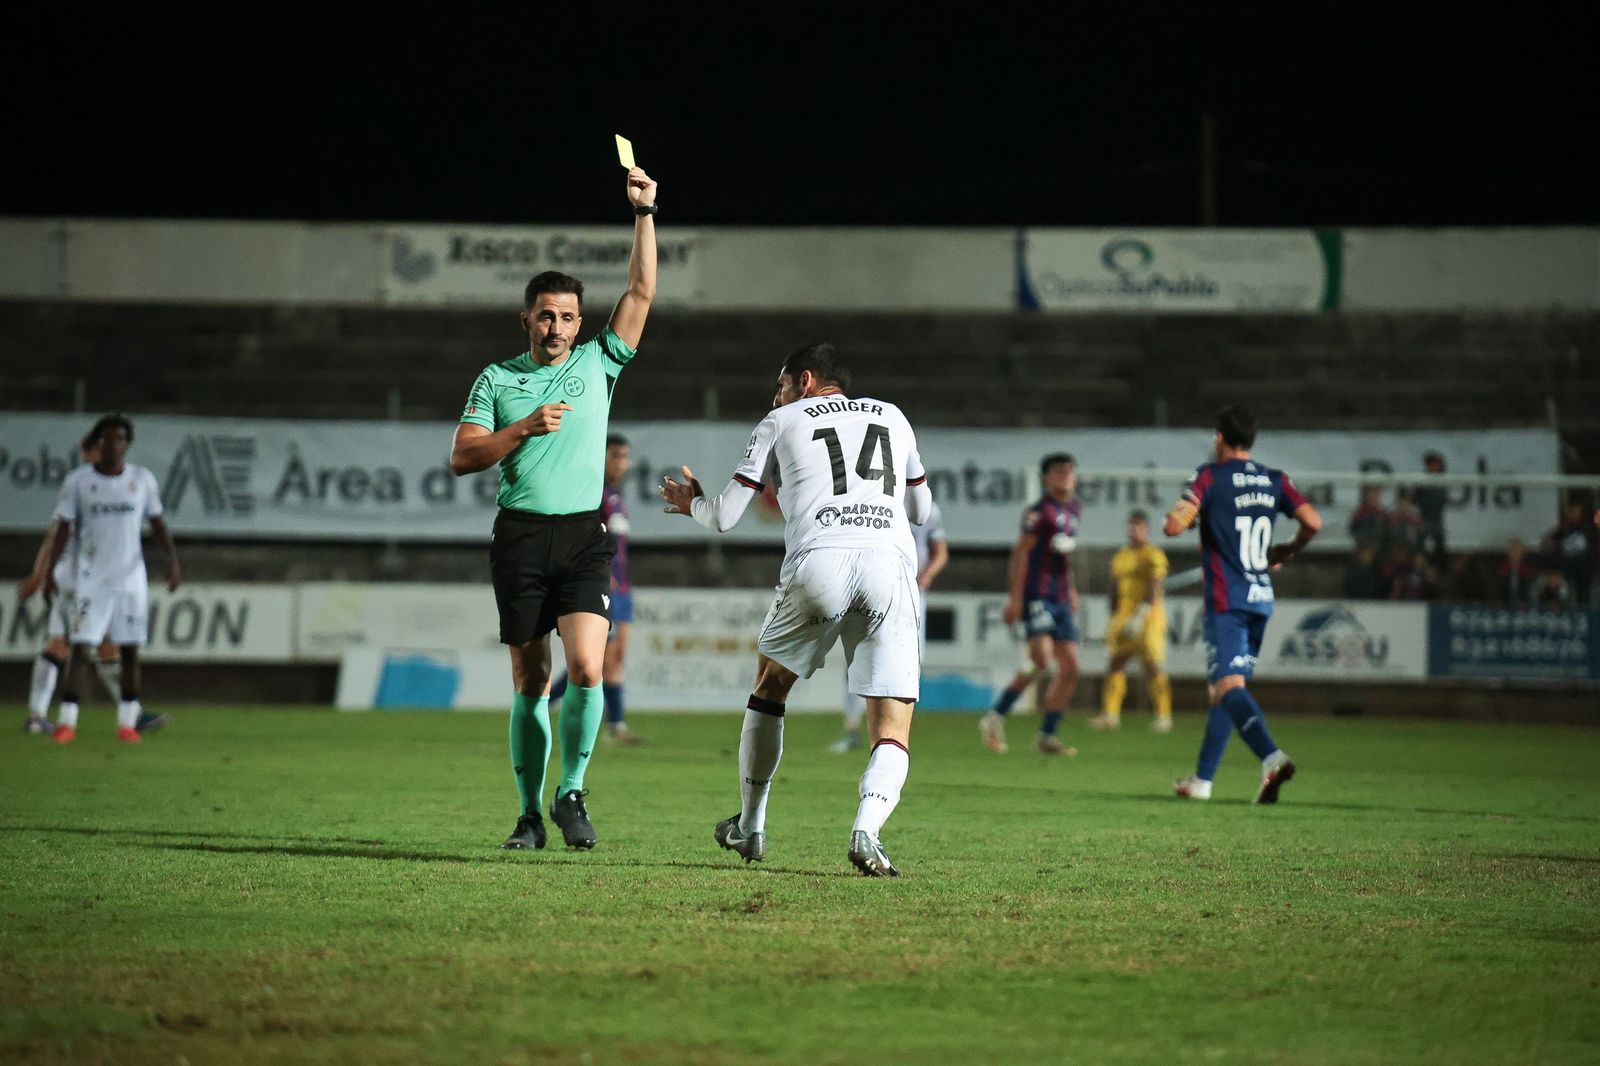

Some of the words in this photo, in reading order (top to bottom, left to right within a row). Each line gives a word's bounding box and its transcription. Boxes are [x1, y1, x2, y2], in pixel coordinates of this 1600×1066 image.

[803, 400, 884, 418] BODIGER
[811, 423, 897, 497] 14
[1234, 515, 1273, 571] 10
